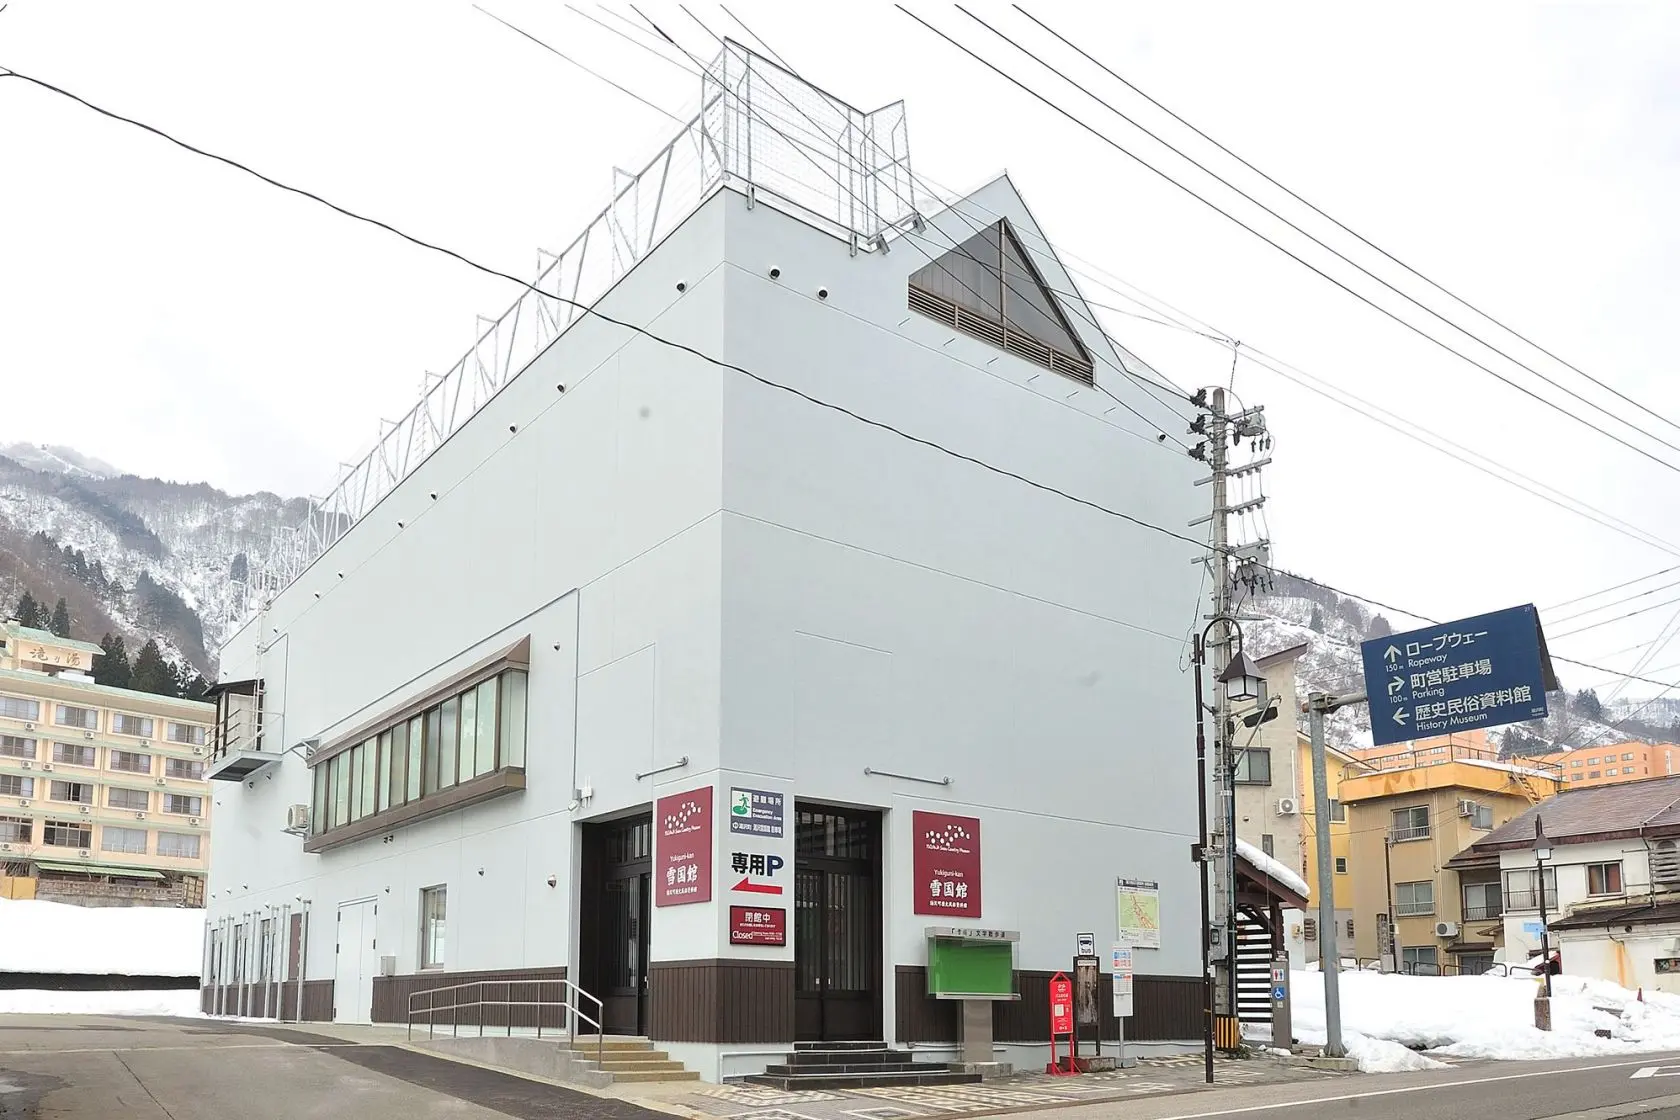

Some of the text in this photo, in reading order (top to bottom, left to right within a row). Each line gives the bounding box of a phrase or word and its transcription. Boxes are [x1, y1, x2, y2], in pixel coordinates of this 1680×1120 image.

[1406, 631, 1488, 656] ロープウェー
[1408, 654, 1448, 668] Ropeway
[1385, 663, 1399, 673] 150
[1410, 658, 1492, 689] 町営駐車場
[1389, 694, 1403, 704] 100
[1412, 687, 1445, 700] Parking
[1415, 685, 1532, 721] 歴史民俗資料館
[1416, 713, 1488, 732] History Museum
[670, 852, 694, 863] Yukiguni-kan
[666, 863, 698, 886] 雪国館
[934, 869, 964, 878] Yukiguni-kan
[930, 879, 968, 899] 雪国館
[745, 911, 771, 923] 閉館中
[732, 930, 753, 940] Closed
